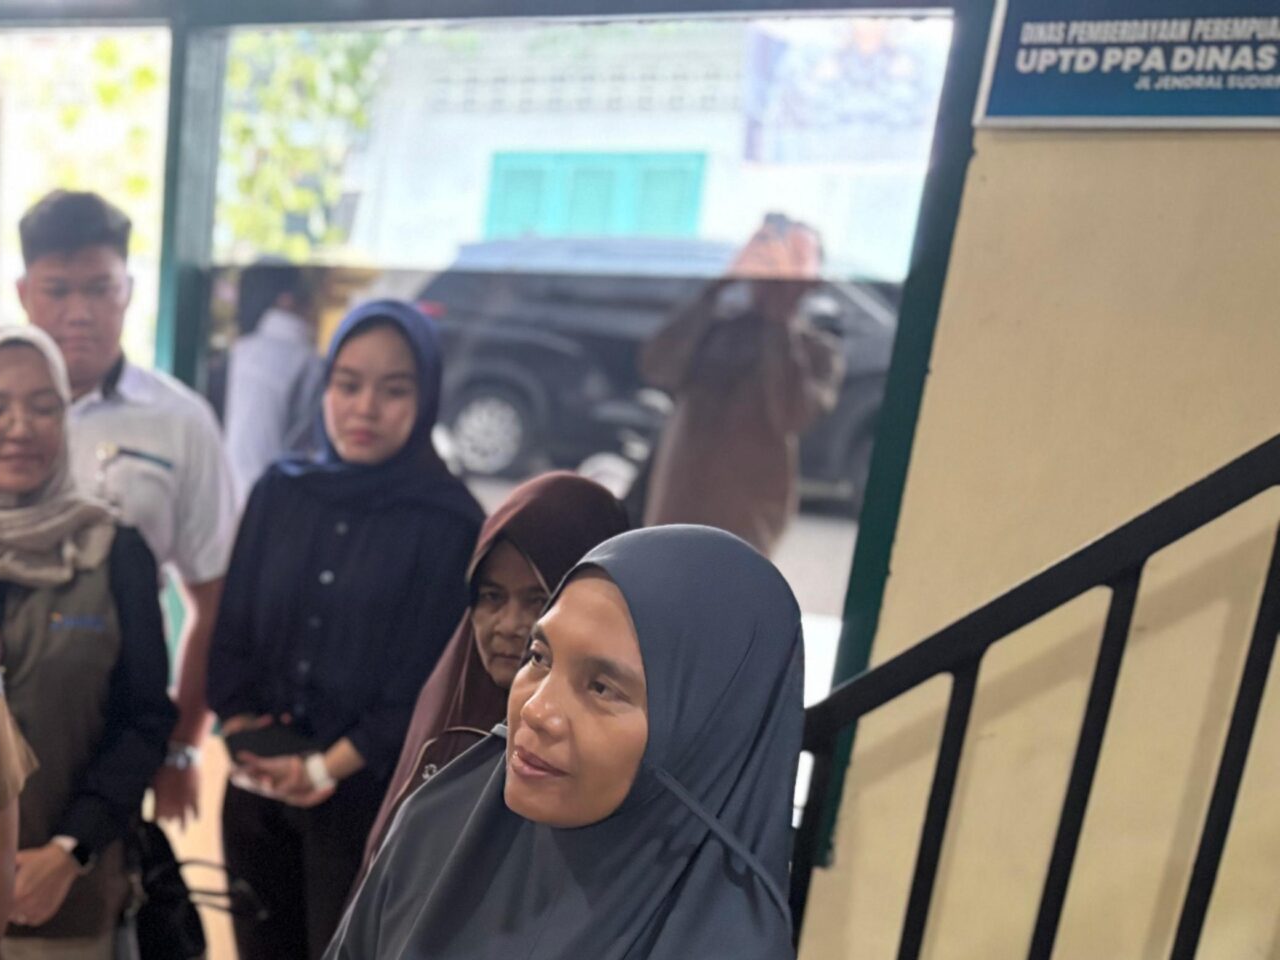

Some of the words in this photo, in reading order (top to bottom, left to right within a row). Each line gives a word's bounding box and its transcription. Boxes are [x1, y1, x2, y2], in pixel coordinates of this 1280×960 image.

[1016, 48, 1098, 73] UPTD
[1101, 46, 1166, 72] PPA
[1170, 45, 1278, 71] DINAS
